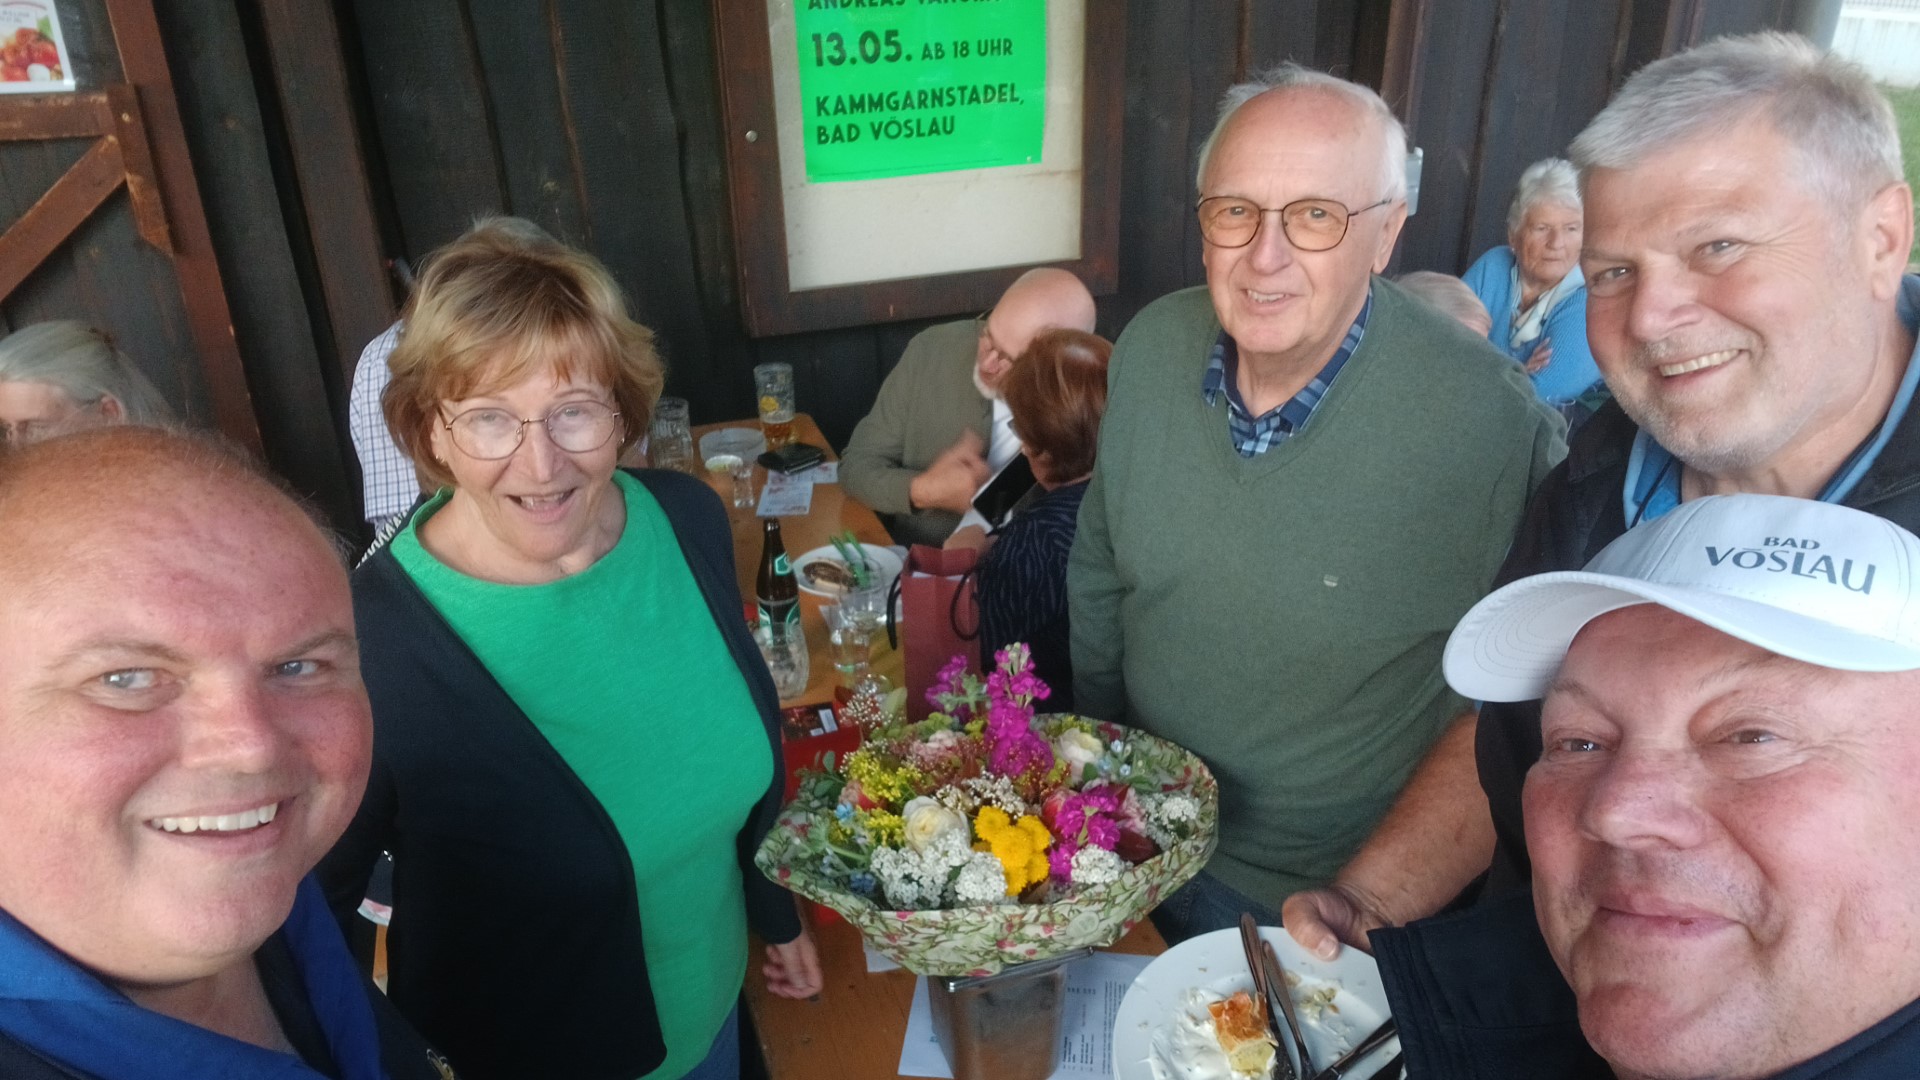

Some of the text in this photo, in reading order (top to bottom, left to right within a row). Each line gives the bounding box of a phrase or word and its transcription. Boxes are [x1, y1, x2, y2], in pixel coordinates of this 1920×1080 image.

[812, 29, 1014, 67] 13.05. AB 18 UHR
[816, 82, 1025, 117] KAMMGARNSTADEL,
[816, 115, 956, 145] BAD VÖSLAU
[1763, 536, 1821, 550] BAD
